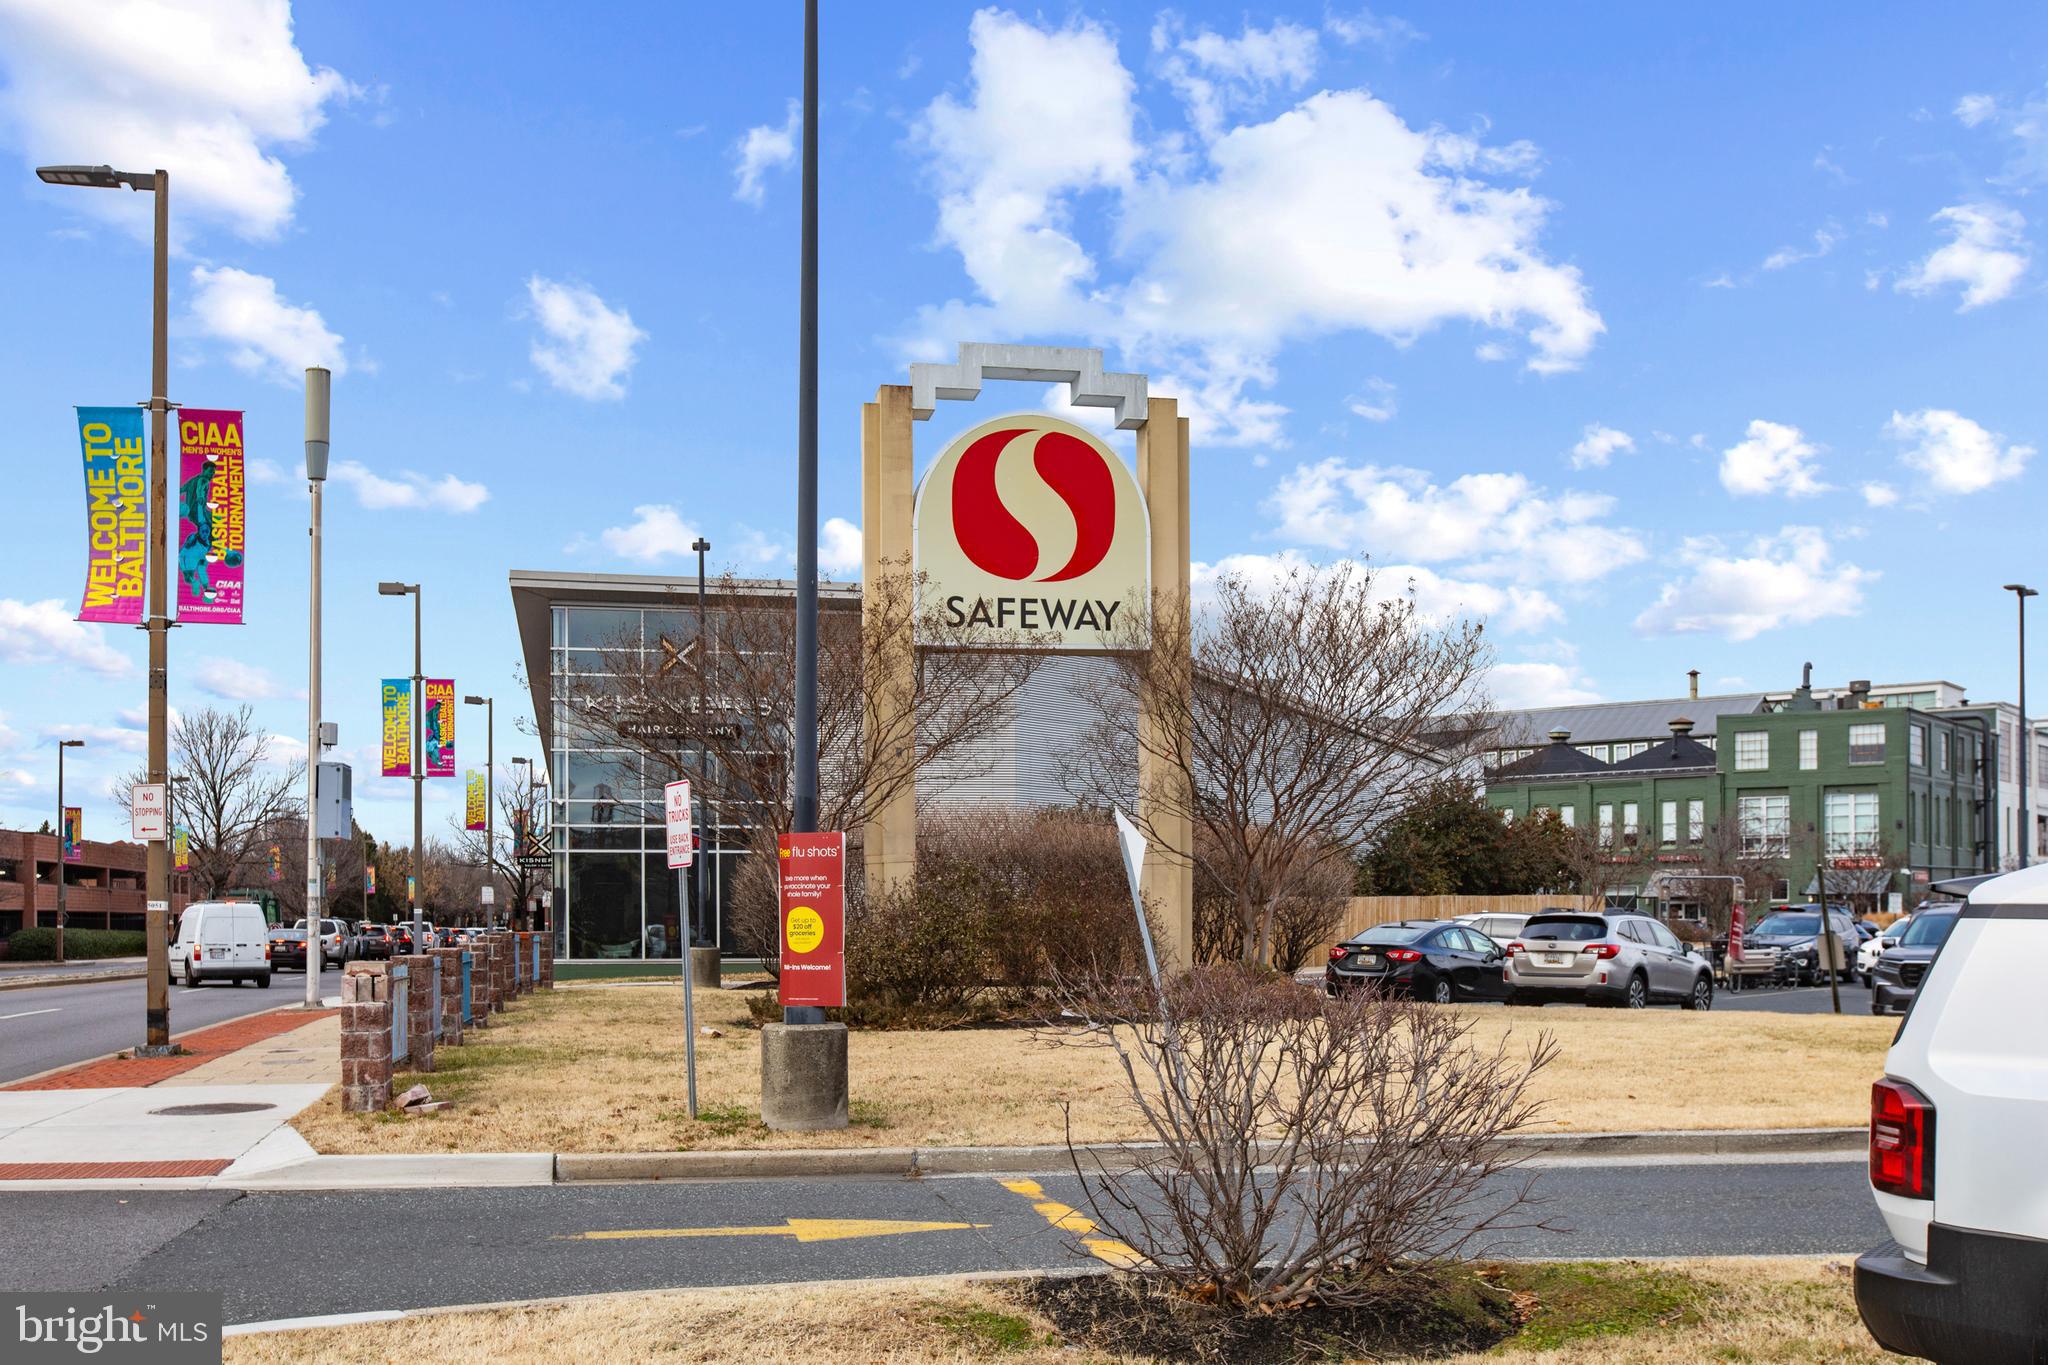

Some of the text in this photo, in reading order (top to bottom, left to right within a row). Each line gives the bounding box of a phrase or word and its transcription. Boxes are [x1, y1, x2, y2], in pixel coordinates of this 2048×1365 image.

[181, 421, 242, 447] CIAA
[182, 446, 204, 454] MEN'S
[210, 447, 242, 456] WOMEN'S
[211, 456, 227, 561] BASKETBALL
[229, 457, 243, 551] TOURNAMENT
[83, 423, 118, 607] WELCOME TO
[114, 437, 146, 598] BALTIMORE
[216, 580, 241, 589] CIAA
[179, 605, 241, 613] BALTIMORE.ORG/CIAA
[946, 595, 1121, 631] SAFEWAY
[426, 684, 454, 695] CIAA
[383, 685, 397, 769] WELCOME TO
[397, 692, 410, 764] BALTIMORE
[628, 724, 660, 734] HAIR
[142, 793, 154, 801] NO
[674, 795, 682, 807] NO
[135, 807, 162, 817] STOPPING
[668, 808, 689, 823] TRUCKS
[670, 834, 678, 845] USE
[678, 832, 689, 843] BACK
[670, 844, 690, 855] ENTRANCE
[792, 846, 805, 857] flu
